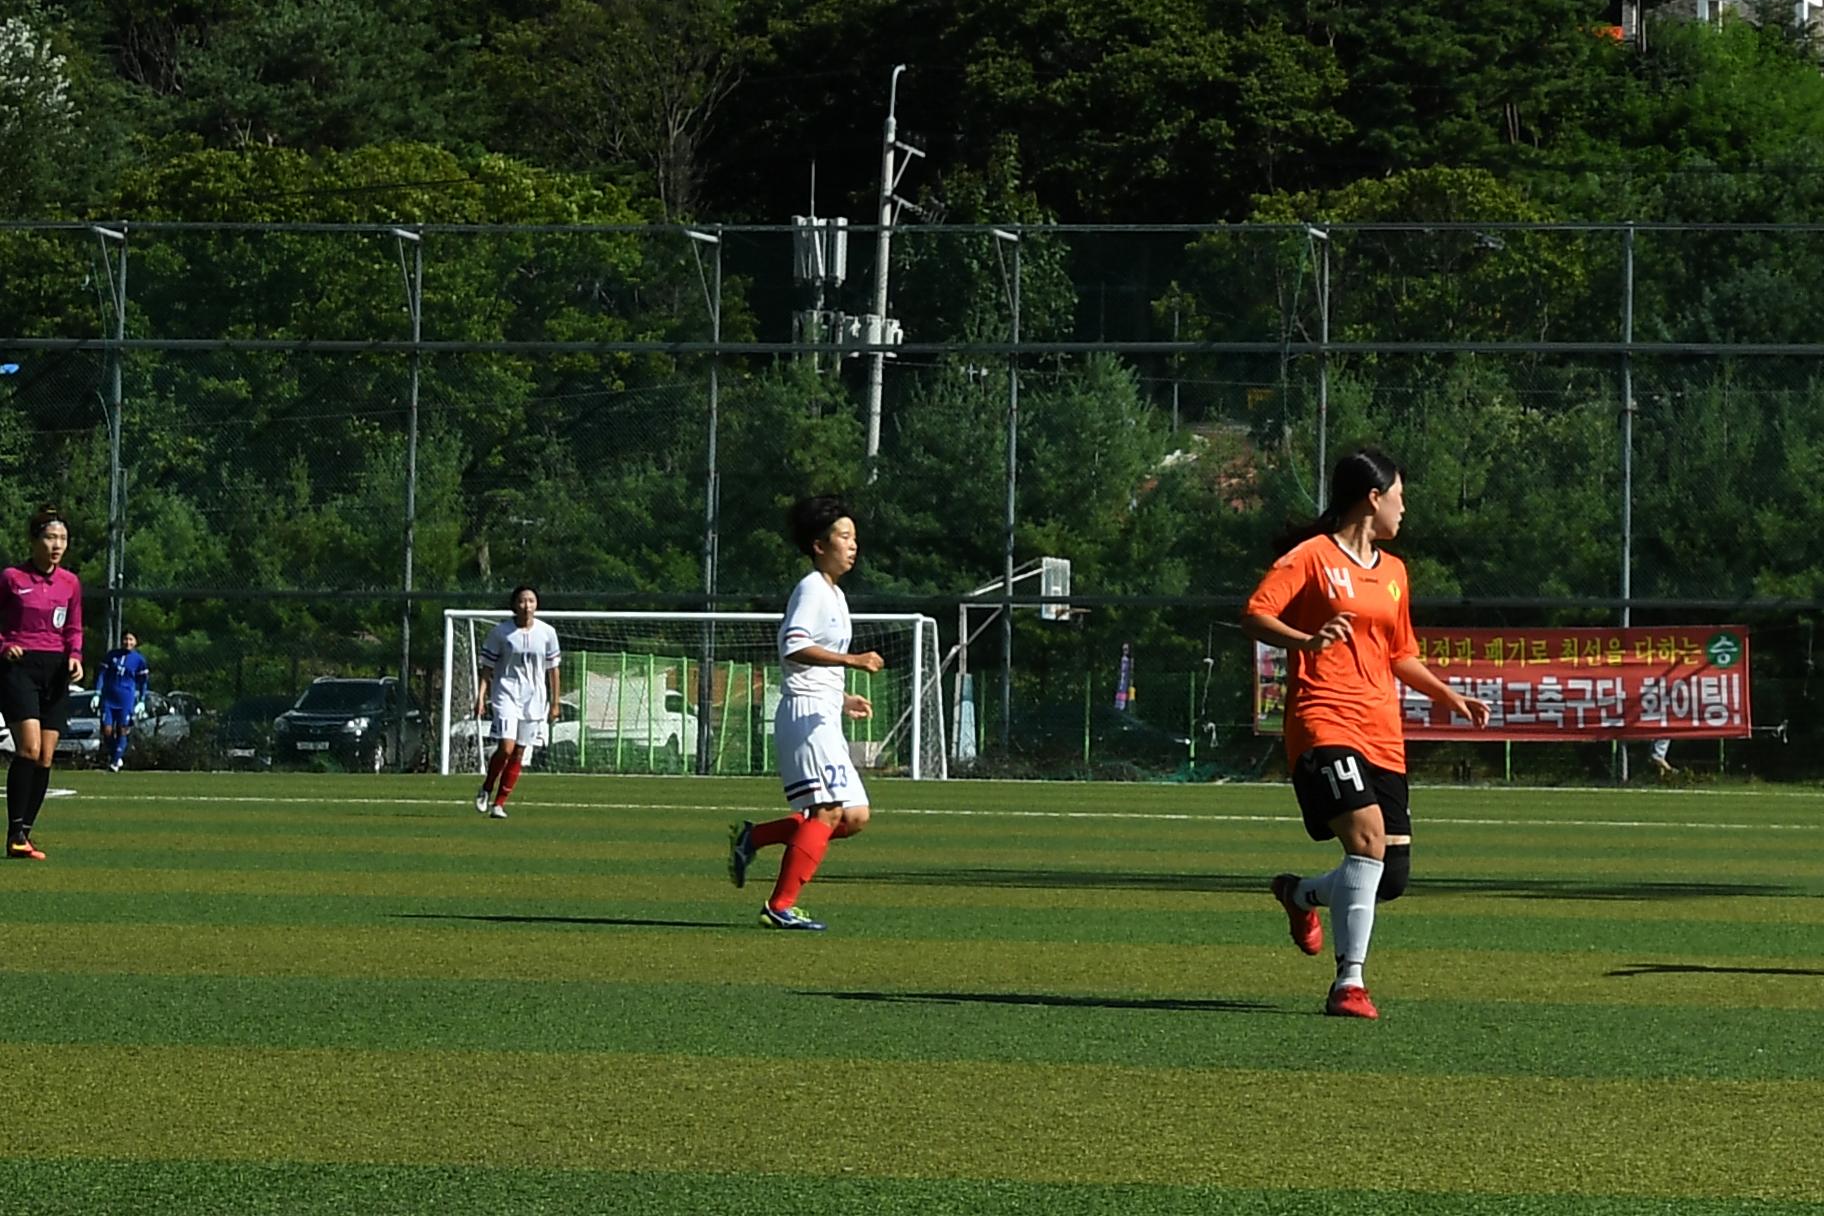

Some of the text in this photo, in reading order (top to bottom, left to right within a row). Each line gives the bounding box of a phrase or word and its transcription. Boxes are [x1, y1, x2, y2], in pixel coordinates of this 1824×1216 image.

[1324, 566, 1355, 599] 14
[1484, 636, 1552, 668] 패기로
[1560, 636, 1627, 667] 최선을
[1634, 634, 1702, 666] 다하는
[1709, 635, 1739, 665] 승
[1640, 673, 1742, 728] 화이팅!
[824, 764, 848, 789] 23
[1320, 755, 1365, 800] 14
